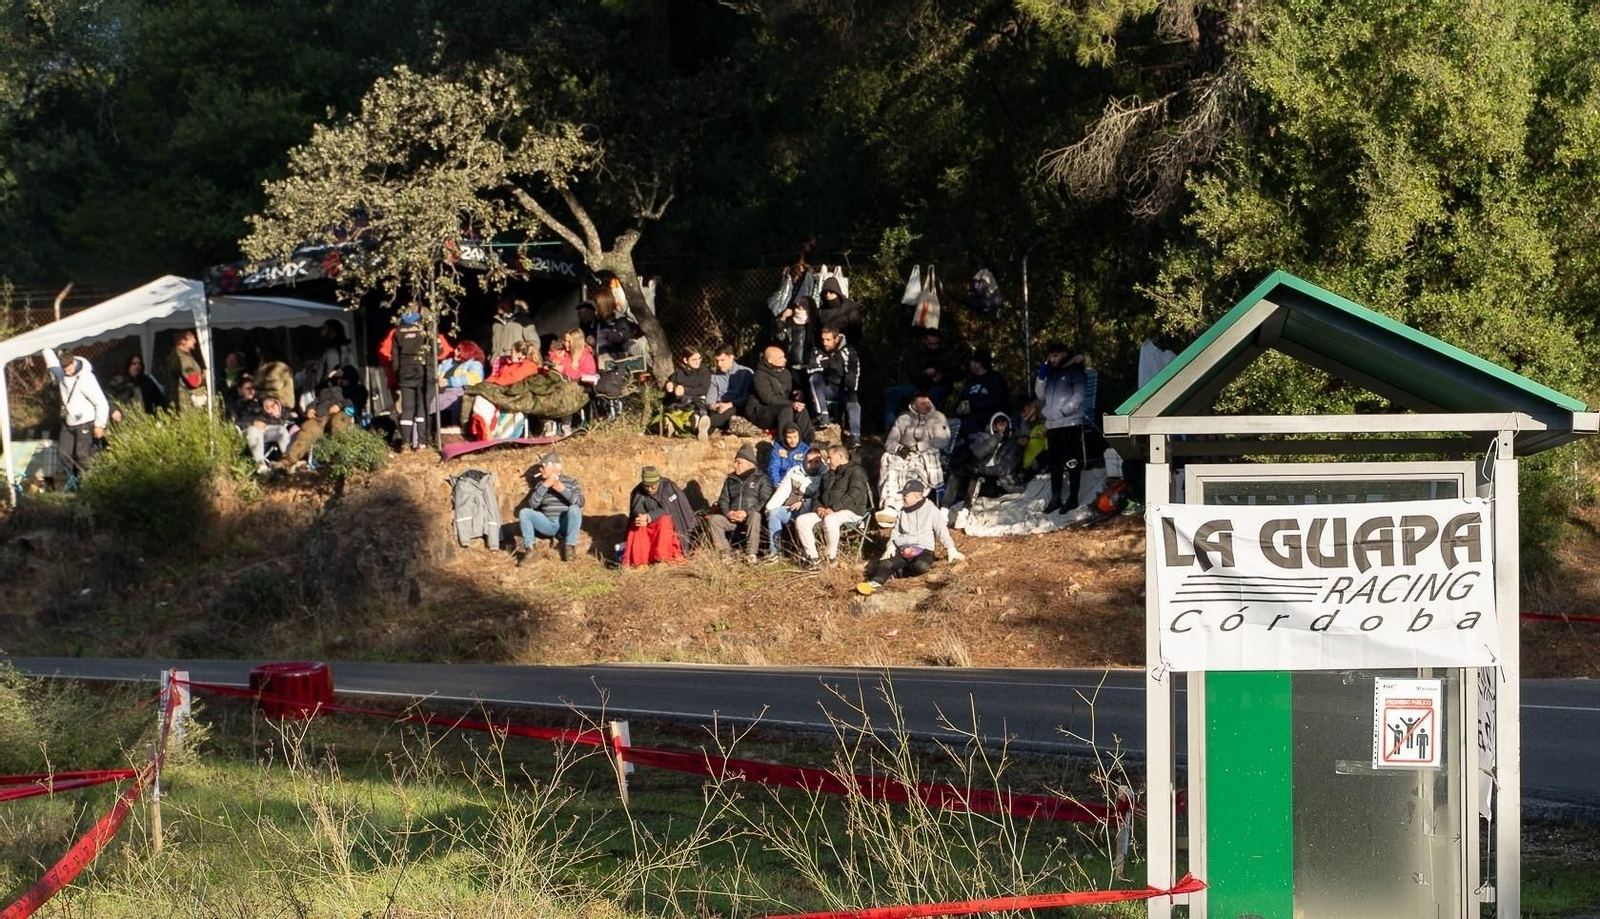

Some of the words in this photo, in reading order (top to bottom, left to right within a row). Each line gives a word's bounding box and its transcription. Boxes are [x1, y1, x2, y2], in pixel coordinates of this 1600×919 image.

[1161, 516, 1236, 573] LA
[1259, 511, 1483, 574] GUAPA
[1321, 570, 1481, 604] RACING
[1169, 606, 1482, 634] Córdoba
